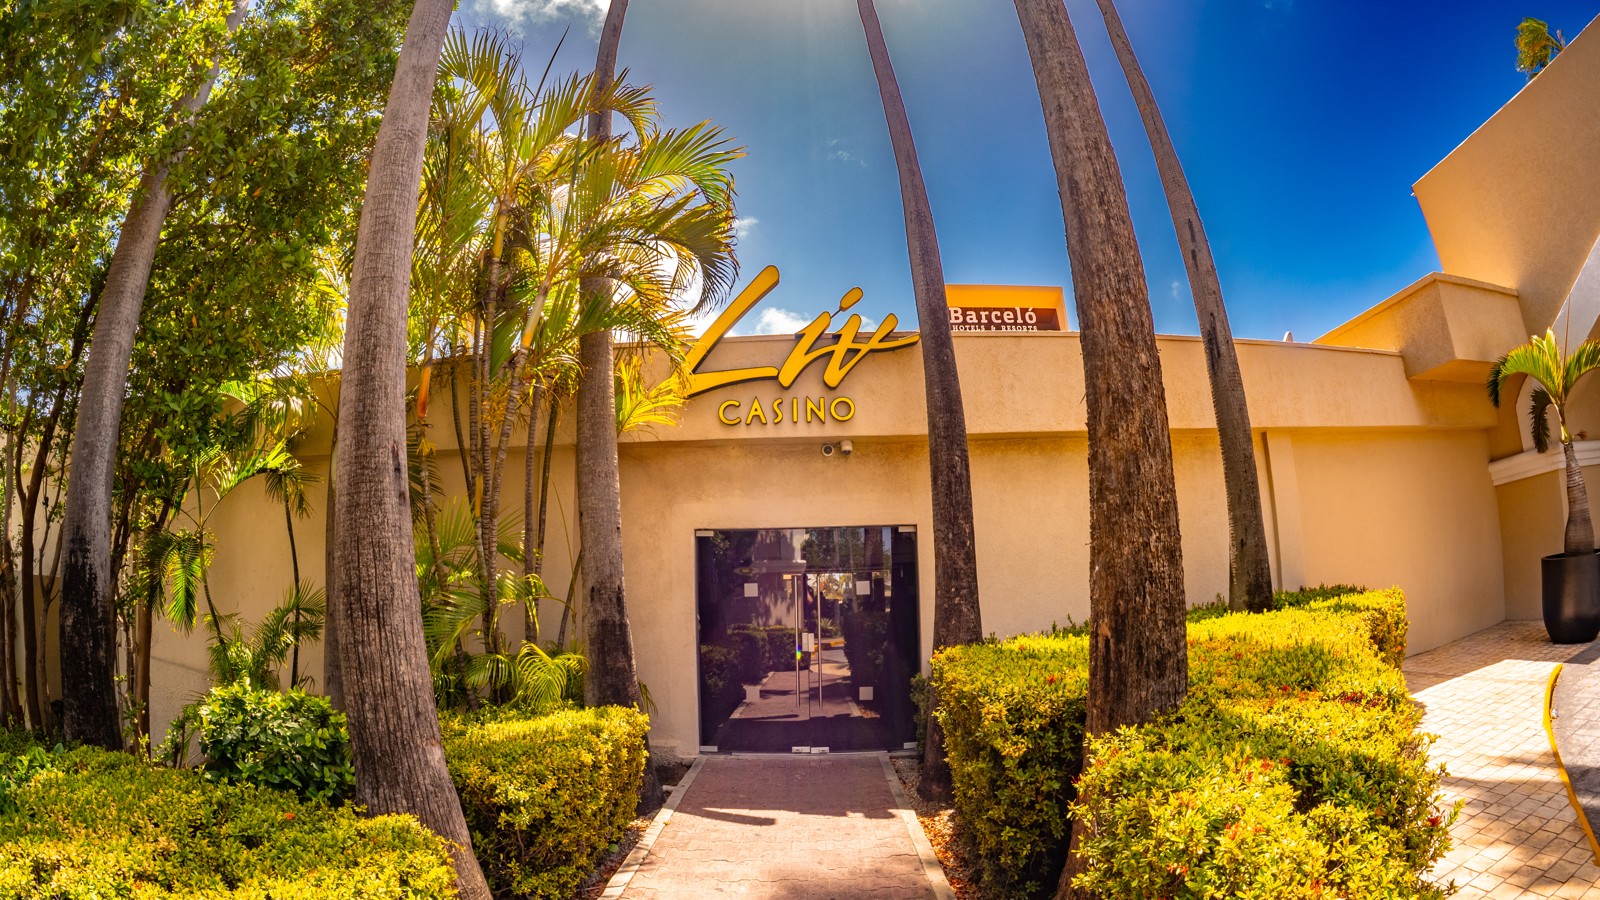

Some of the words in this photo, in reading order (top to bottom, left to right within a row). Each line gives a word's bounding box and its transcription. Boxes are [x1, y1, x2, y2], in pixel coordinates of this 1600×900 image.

[948, 306, 1037, 324] Barceló
[684, 264, 921, 399] Liv
[718, 396, 856, 426] CASINO
